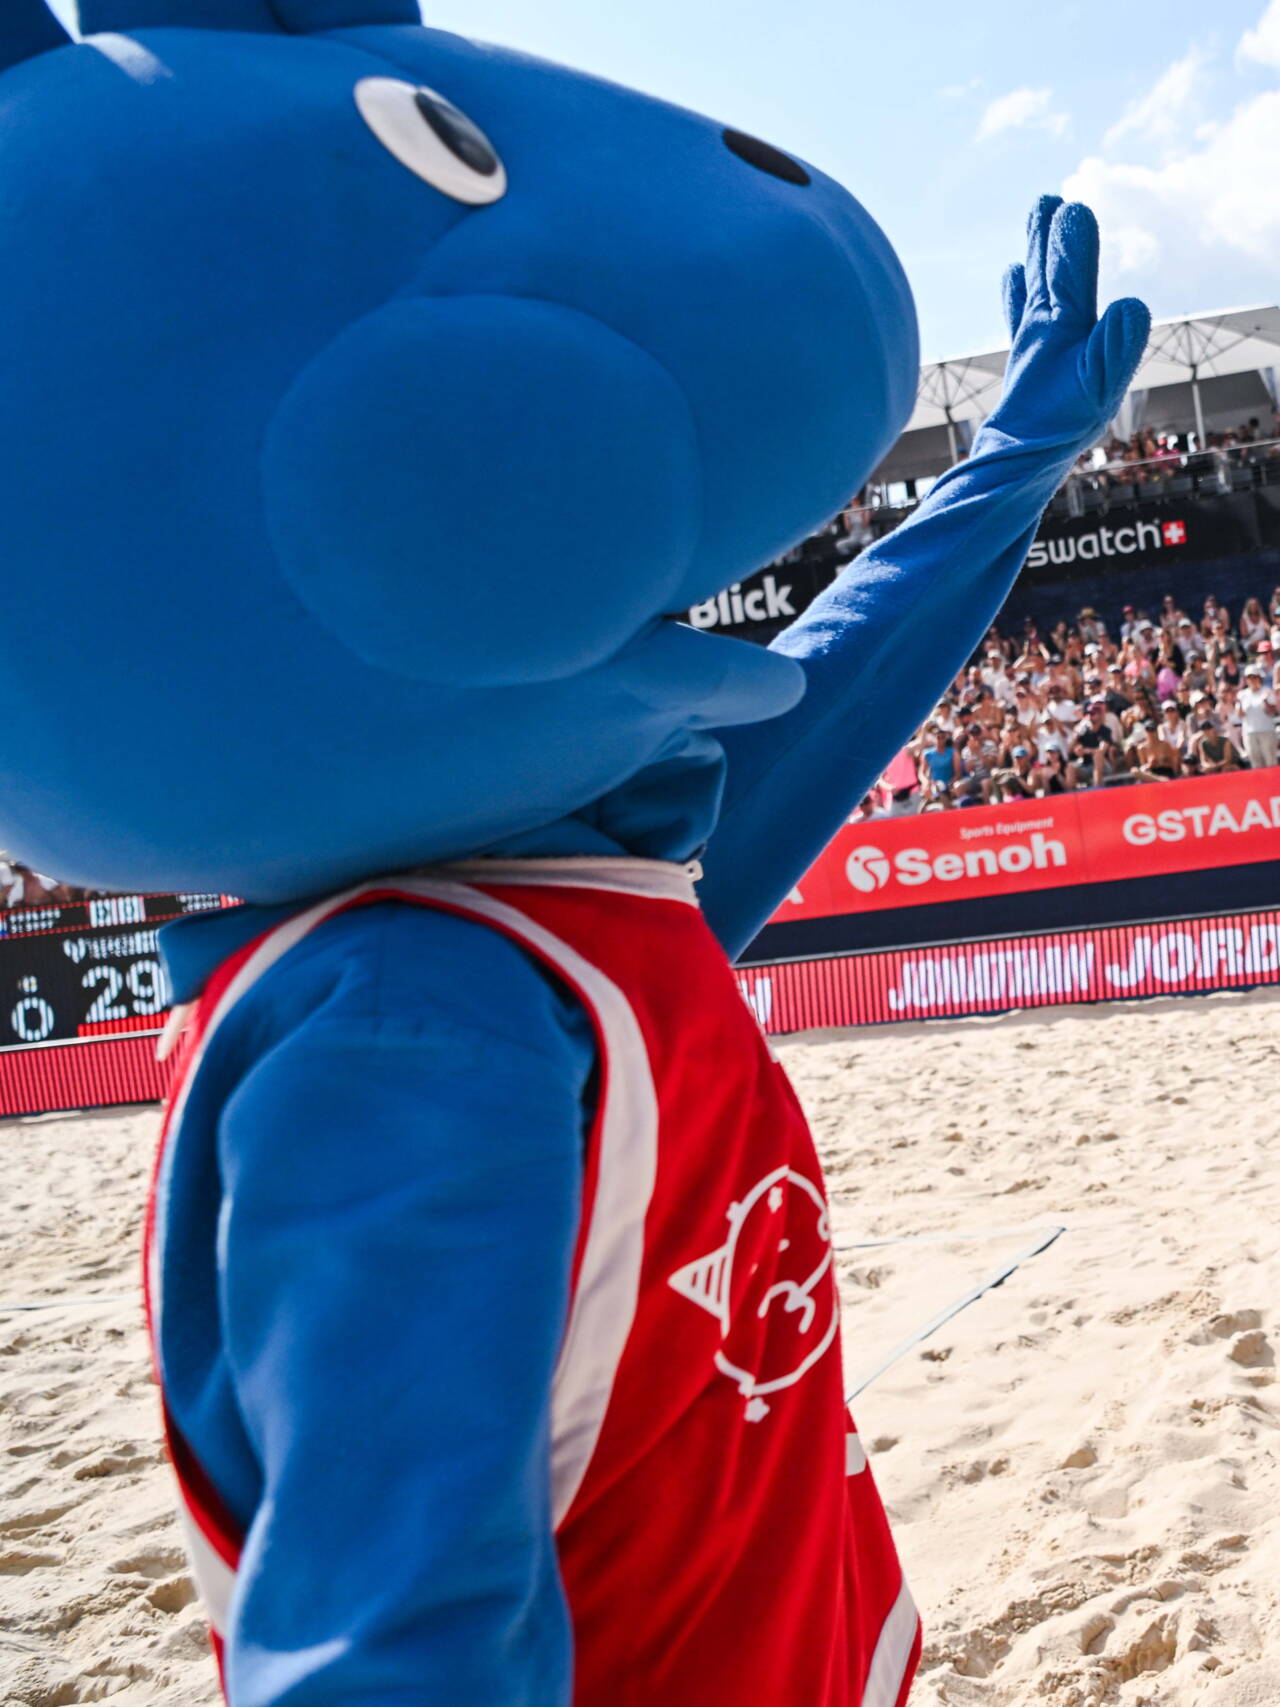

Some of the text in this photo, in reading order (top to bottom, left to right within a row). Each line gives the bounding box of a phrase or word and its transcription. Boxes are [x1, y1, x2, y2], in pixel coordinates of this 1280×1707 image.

[1026, 519, 1162, 568] swatch
[960, 816, 1054, 841] Sports Equipment
[895, 832, 1068, 887] Senoh
[81, 959, 169, 1024] 29
